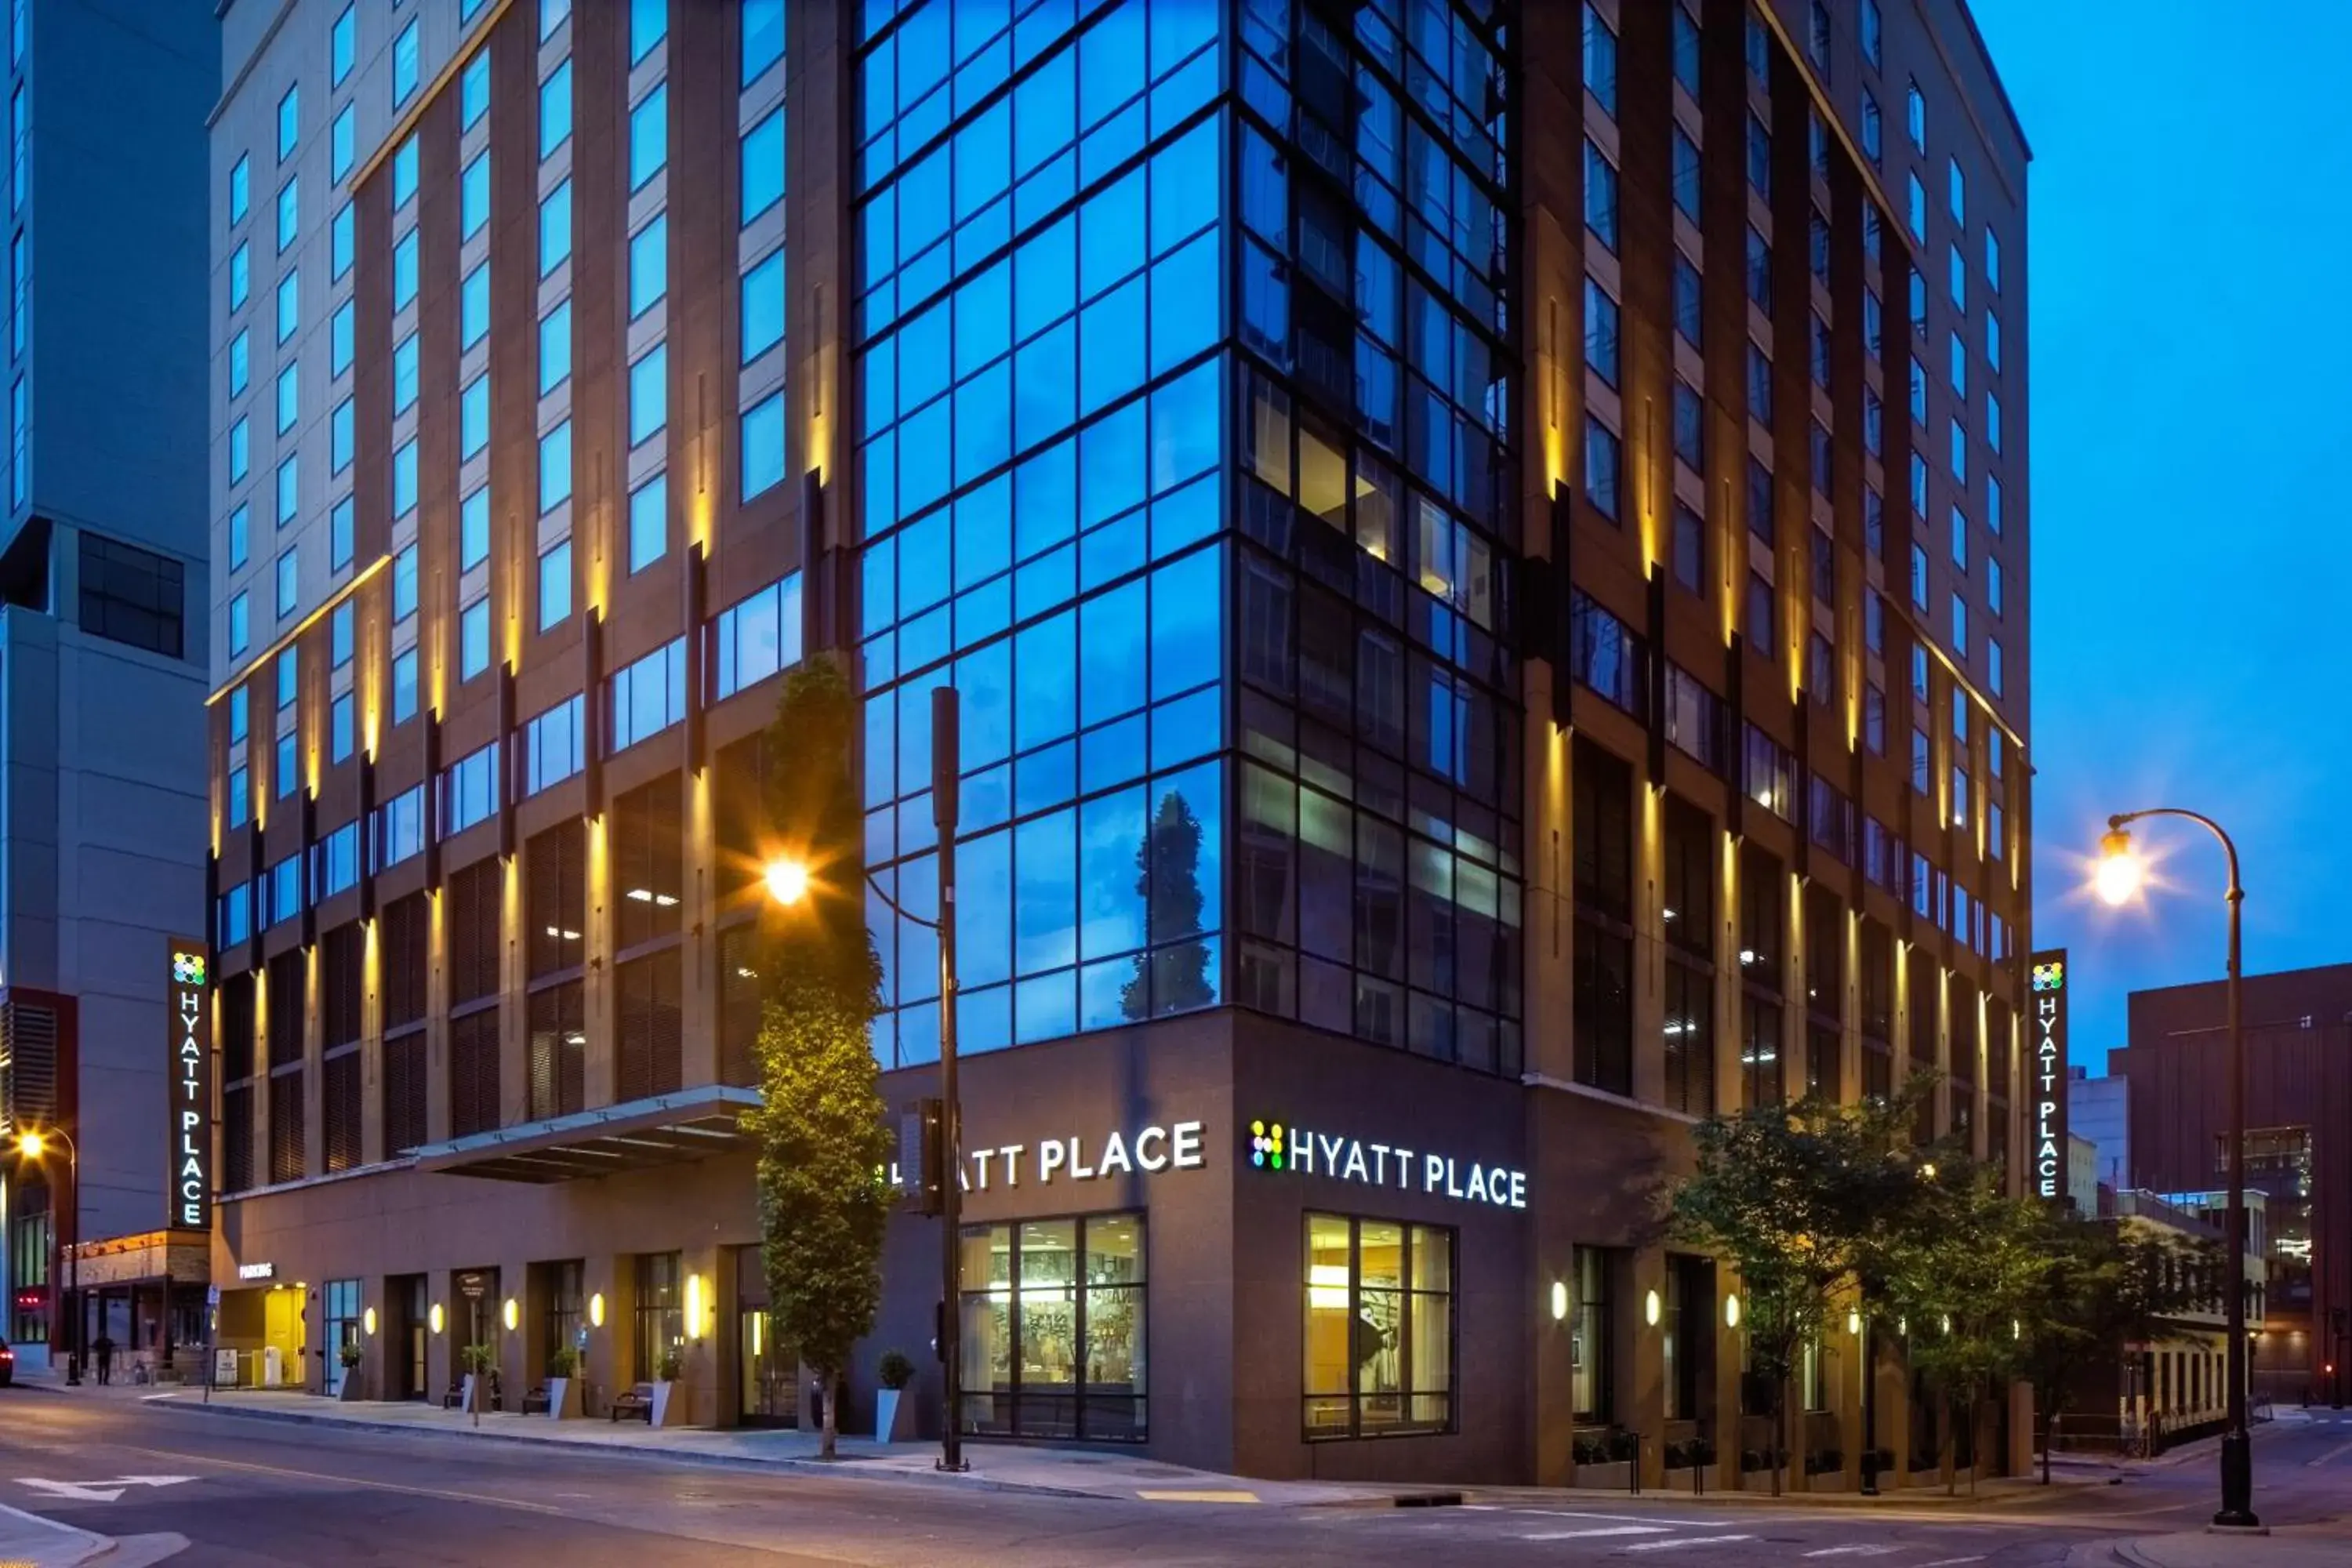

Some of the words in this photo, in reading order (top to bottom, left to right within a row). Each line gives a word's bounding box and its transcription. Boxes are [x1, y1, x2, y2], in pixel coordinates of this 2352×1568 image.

[181, 991, 201, 1101] HYATT
[2038, 996, 2057, 1093] HYATT
[182, 1110, 203, 1225] PLACE
[1040, 1120, 1203, 1182] PLACE
[1290, 1127, 1414, 1189] HYATT
[1425, 1153, 1527, 1208] PLACE
[2038, 1101, 2059, 1197] PLACE
